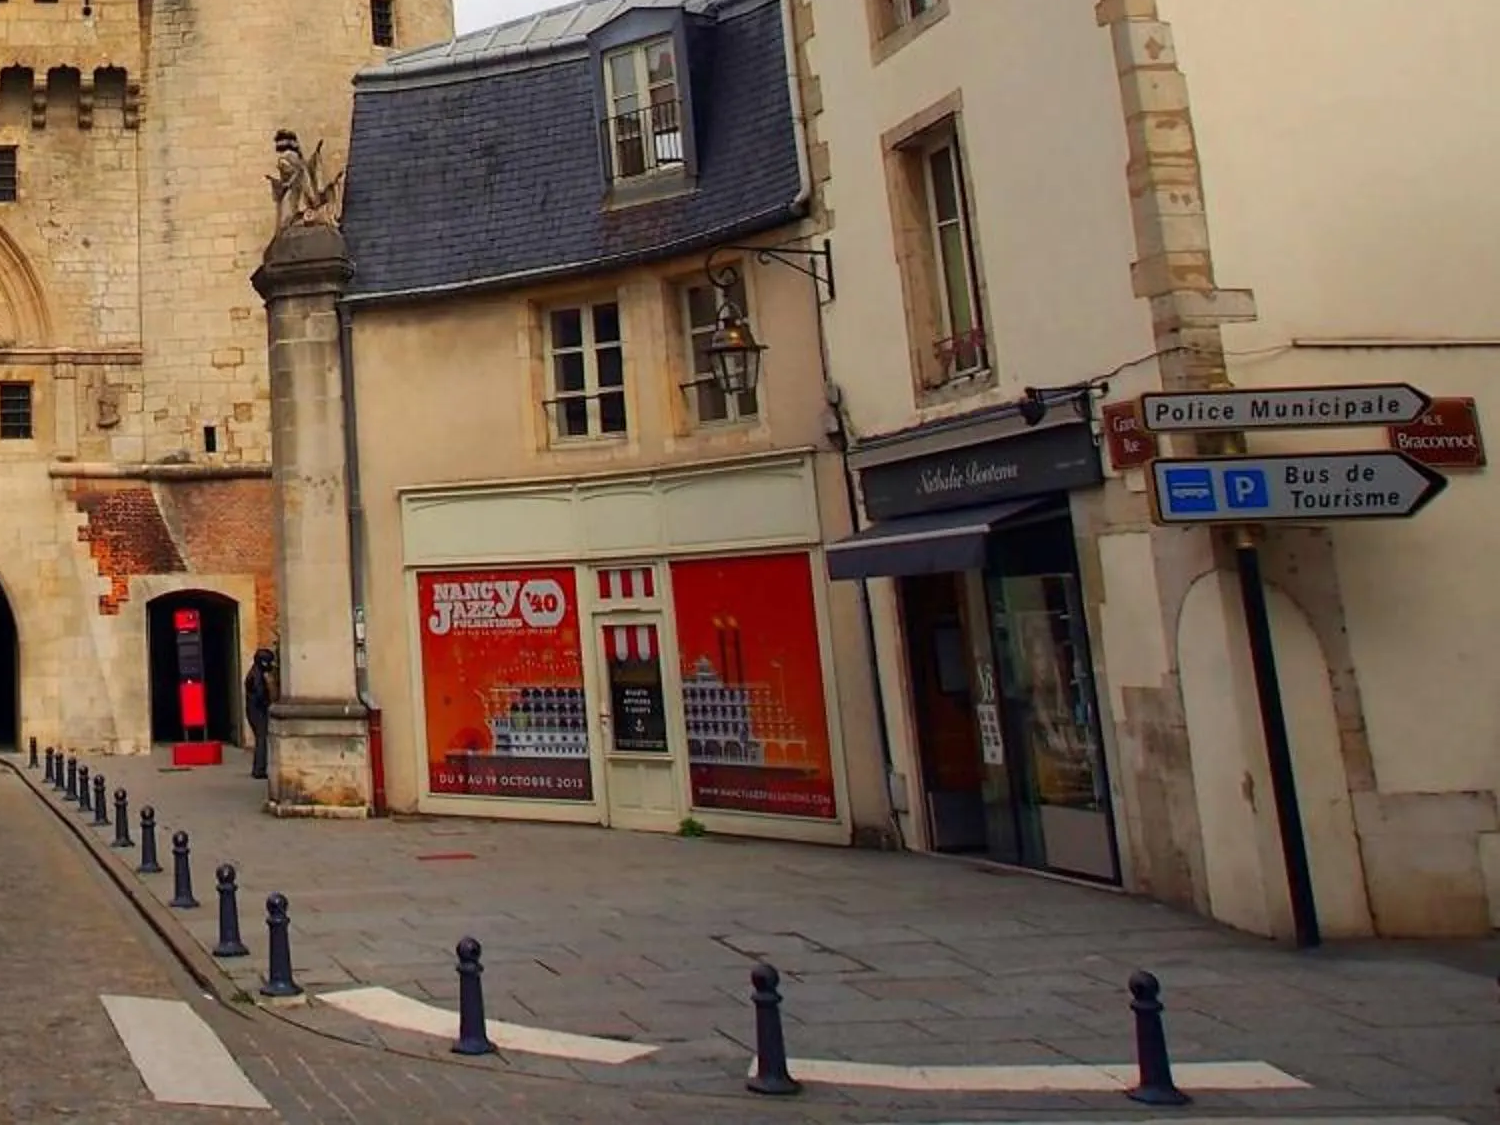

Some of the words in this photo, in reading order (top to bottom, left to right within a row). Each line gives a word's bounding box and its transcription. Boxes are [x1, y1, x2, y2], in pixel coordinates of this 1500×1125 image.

[1155, 402, 1235, 422] Police
[1251, 394, 1400, 419] Municipale
[1398, 432, 1477, 449] Braconnot
[1233, 476, 1256, 503] P
[1285, 466, 1330, 485] Bus
[1346, 463, 1375, 483] de
[1291, 489, 1401, 509] Tourisme
[432, 581, 520, 617] NANCY
[428, 600, 497, 635] JAZZ
[439, 774, 455, 785] DU
[467, 775, 483, 785] AU
[500, 776, 552, 788] OCTOBRE
